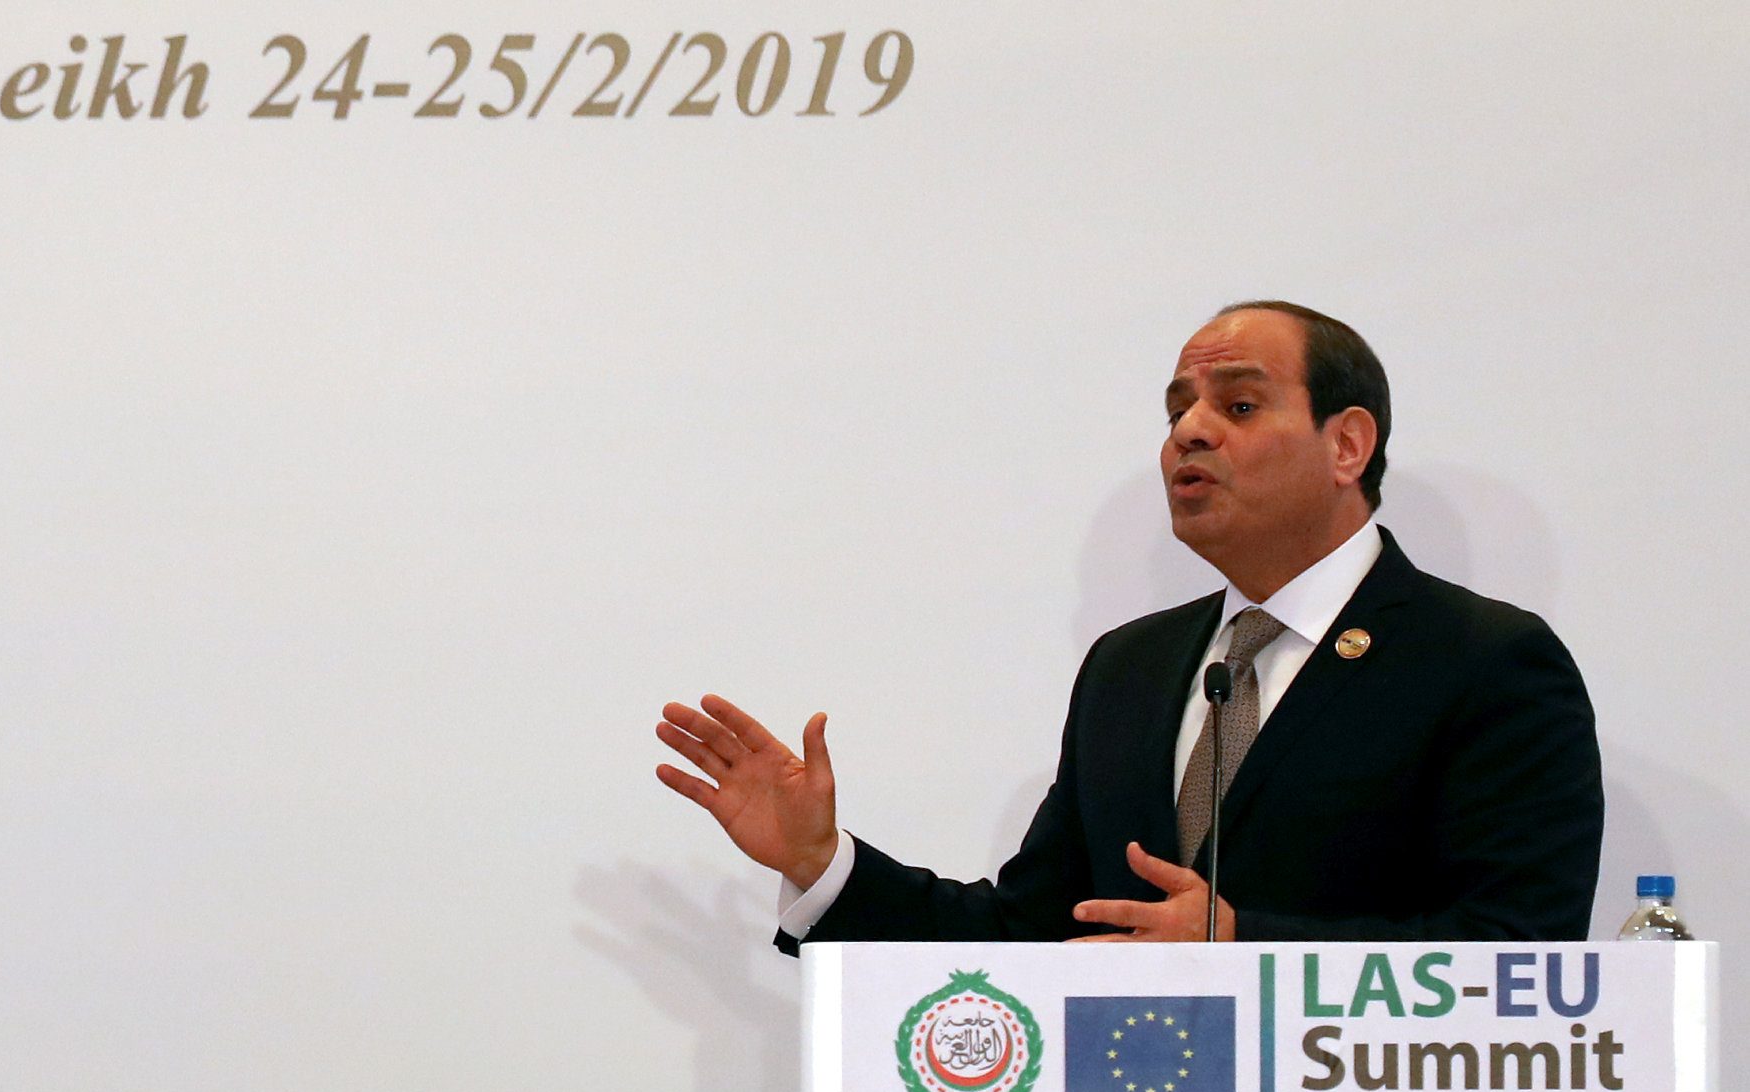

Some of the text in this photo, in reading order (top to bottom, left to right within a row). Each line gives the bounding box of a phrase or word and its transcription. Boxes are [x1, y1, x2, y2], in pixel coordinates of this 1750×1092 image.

[248, 30, 917, 122] 24-25/2/2019
[1303, 952, 1602, 1019] LAS-EU
[1301, 1023, 1626, 1092] Summit
